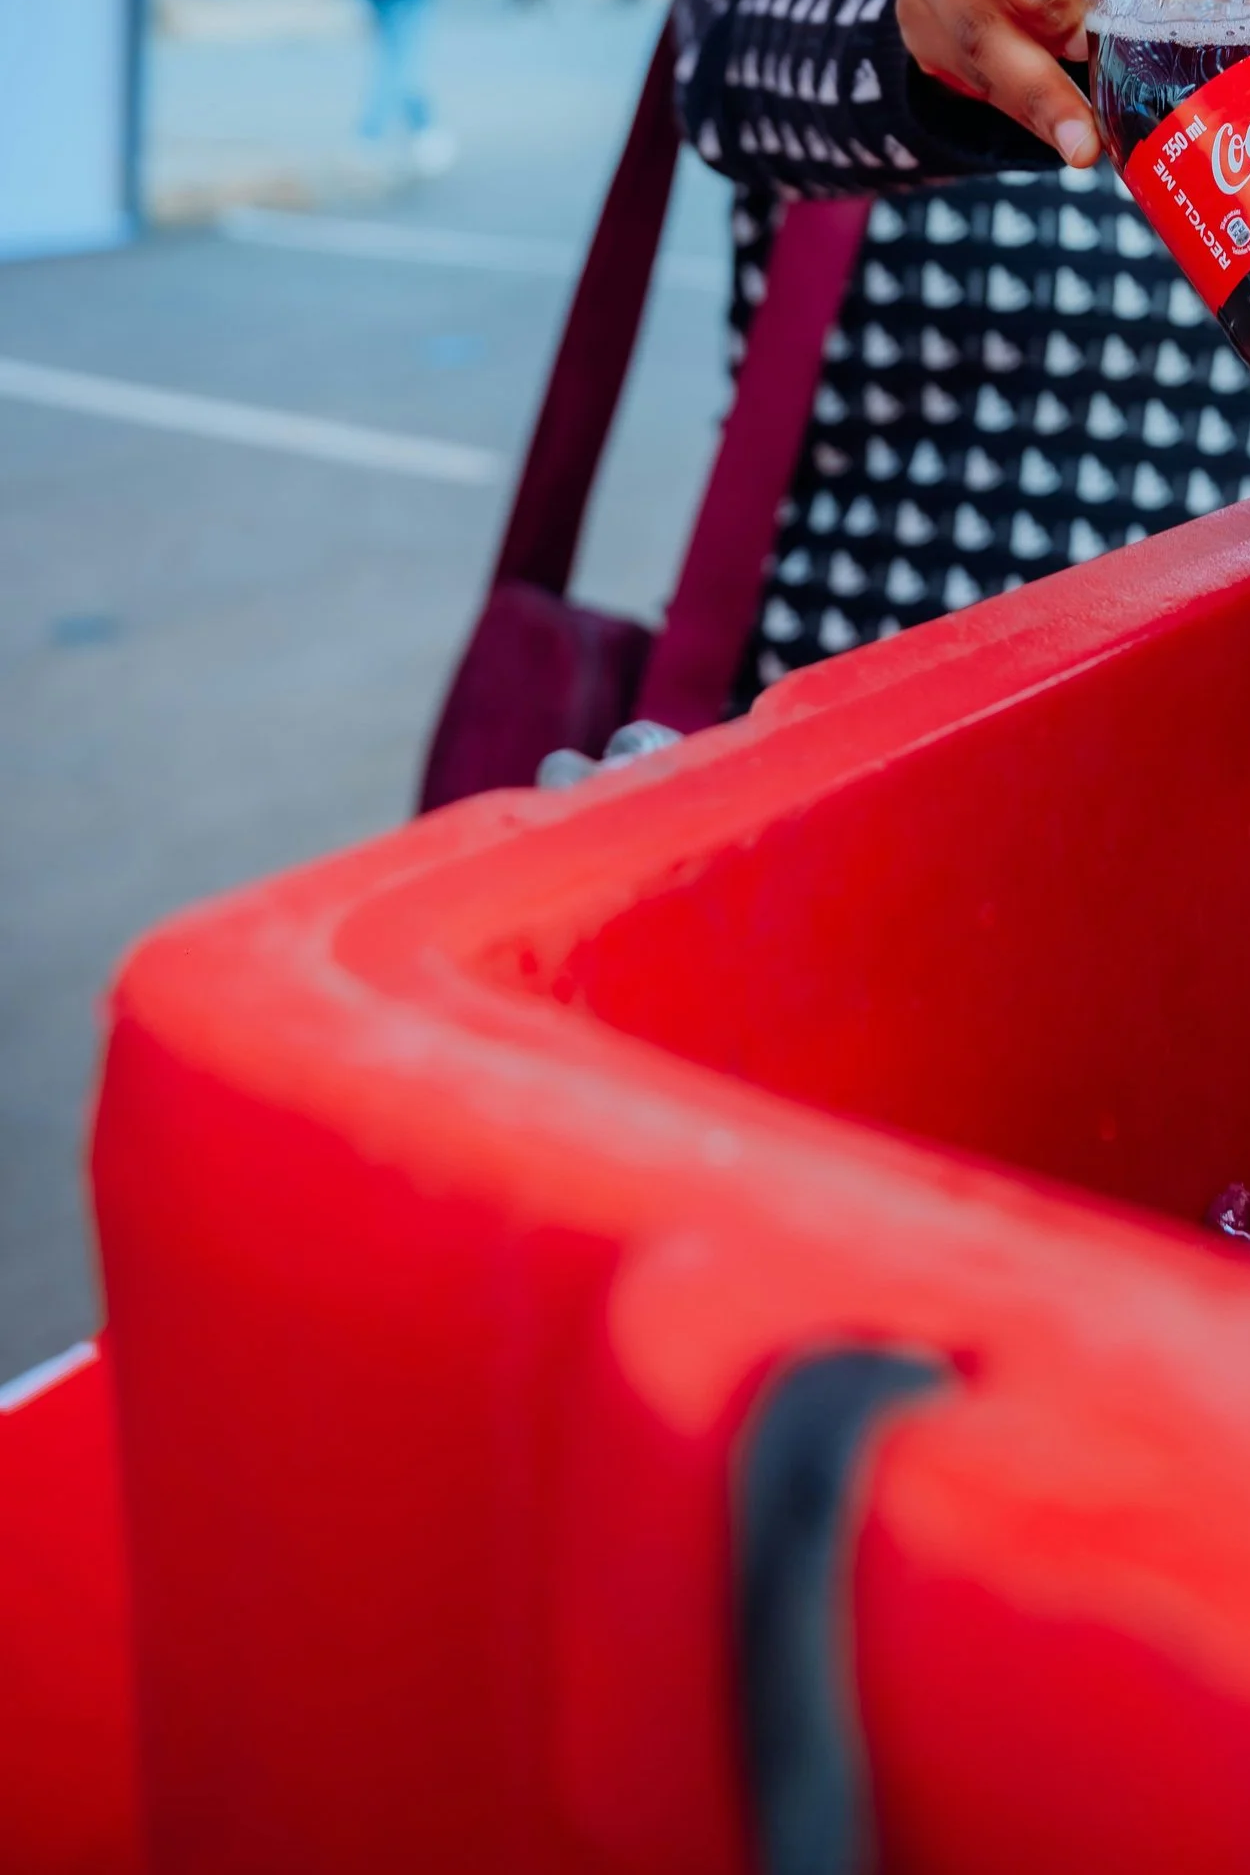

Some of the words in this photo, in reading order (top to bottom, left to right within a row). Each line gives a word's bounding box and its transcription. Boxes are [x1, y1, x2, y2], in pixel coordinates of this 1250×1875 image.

[1162, 130, 1189, 163] 350
[1185, 114, 1208, 141] ml
[1152, 158, 1177, 192] ME
[1173, 188, 1232, 270] RECYCLE
